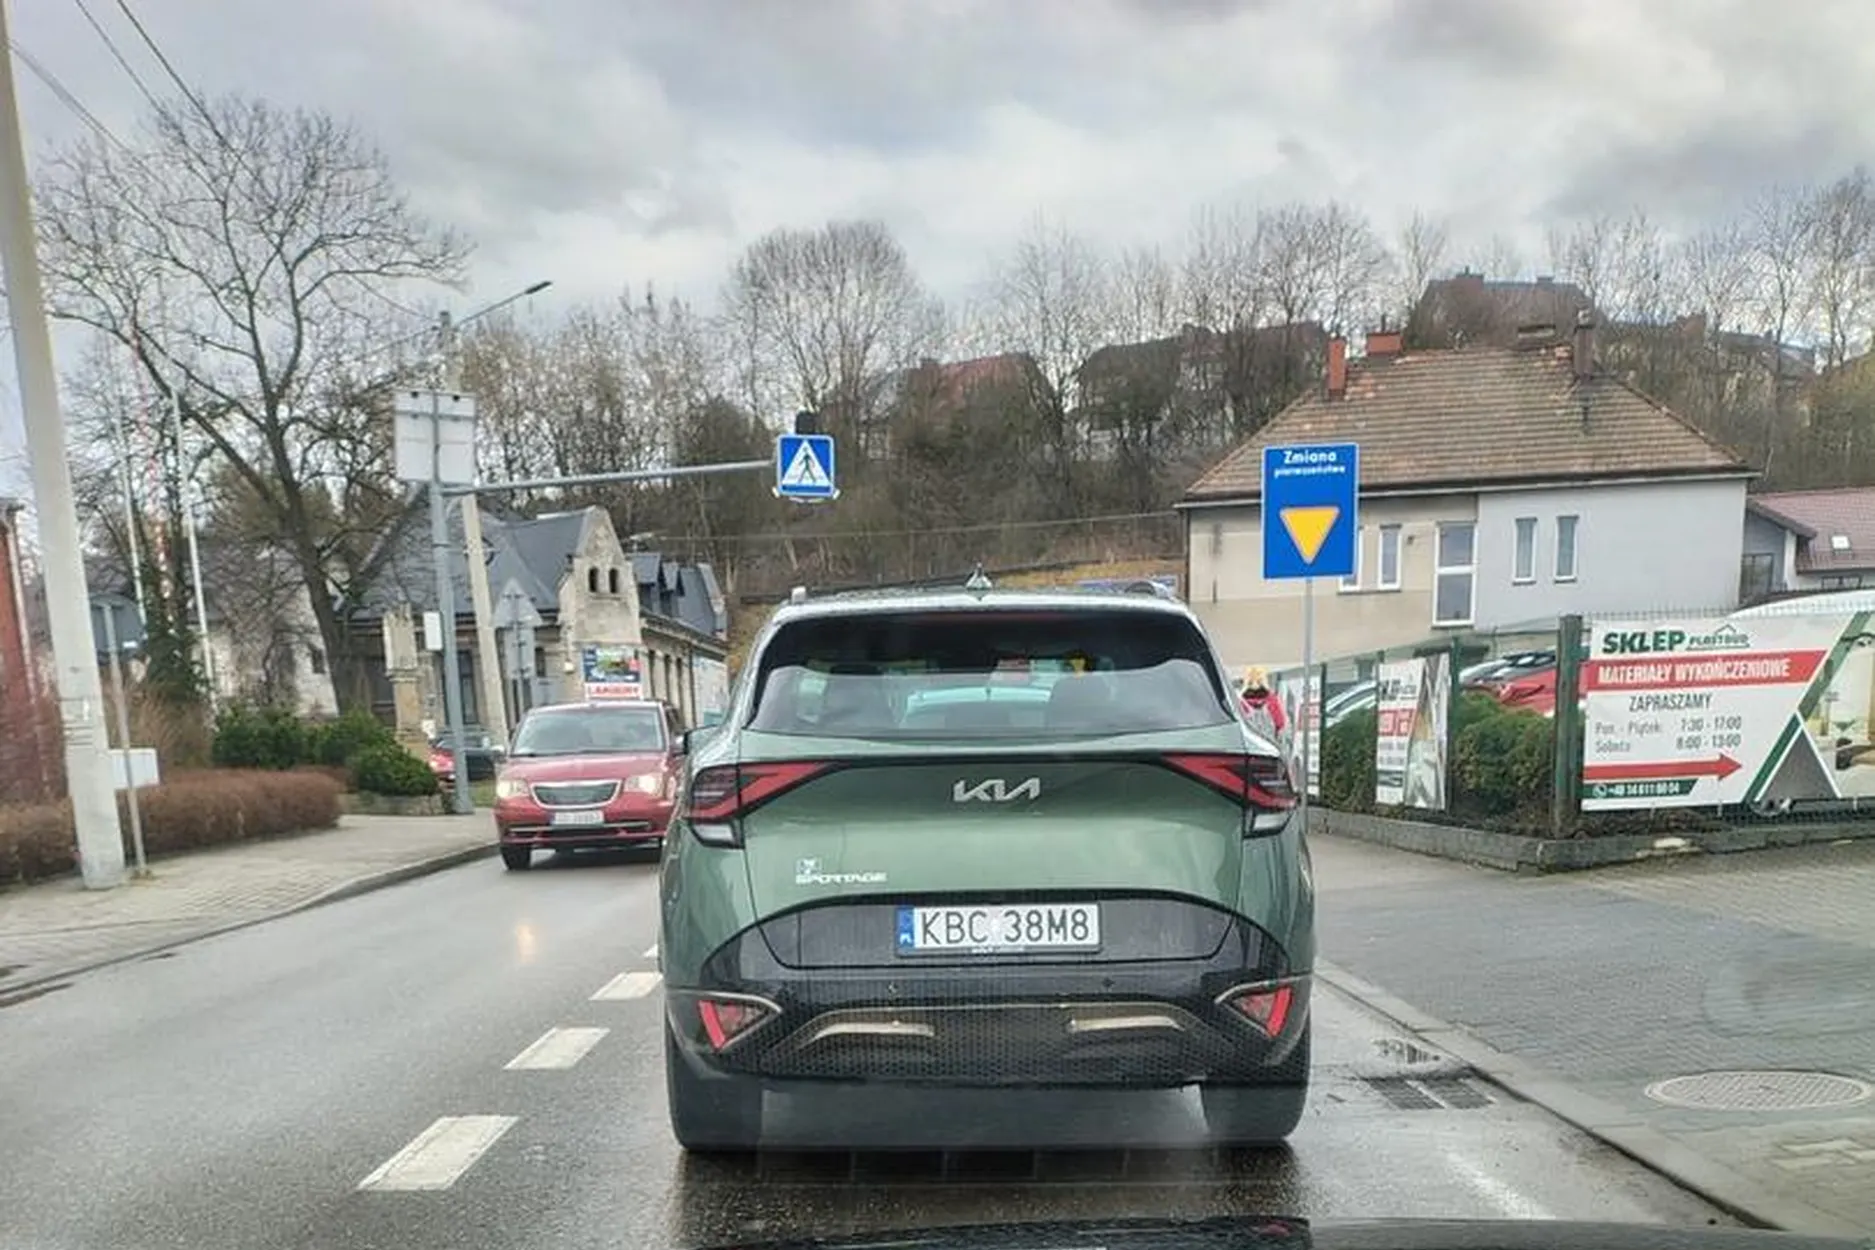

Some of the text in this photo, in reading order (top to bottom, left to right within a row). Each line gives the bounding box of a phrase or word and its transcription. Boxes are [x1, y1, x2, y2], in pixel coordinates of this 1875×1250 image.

[1283, 450, 1337, 465] Zmiana
[1602, 630, 1686, 654] SKLEP
[1629, 693, 1713, 712] ZAPRASZAMY
[1714, 715, 1742, 730] 17:00
[953, 777, 1040, 801] KIA
[921, 908, 1090, 945] KBC 38M8
